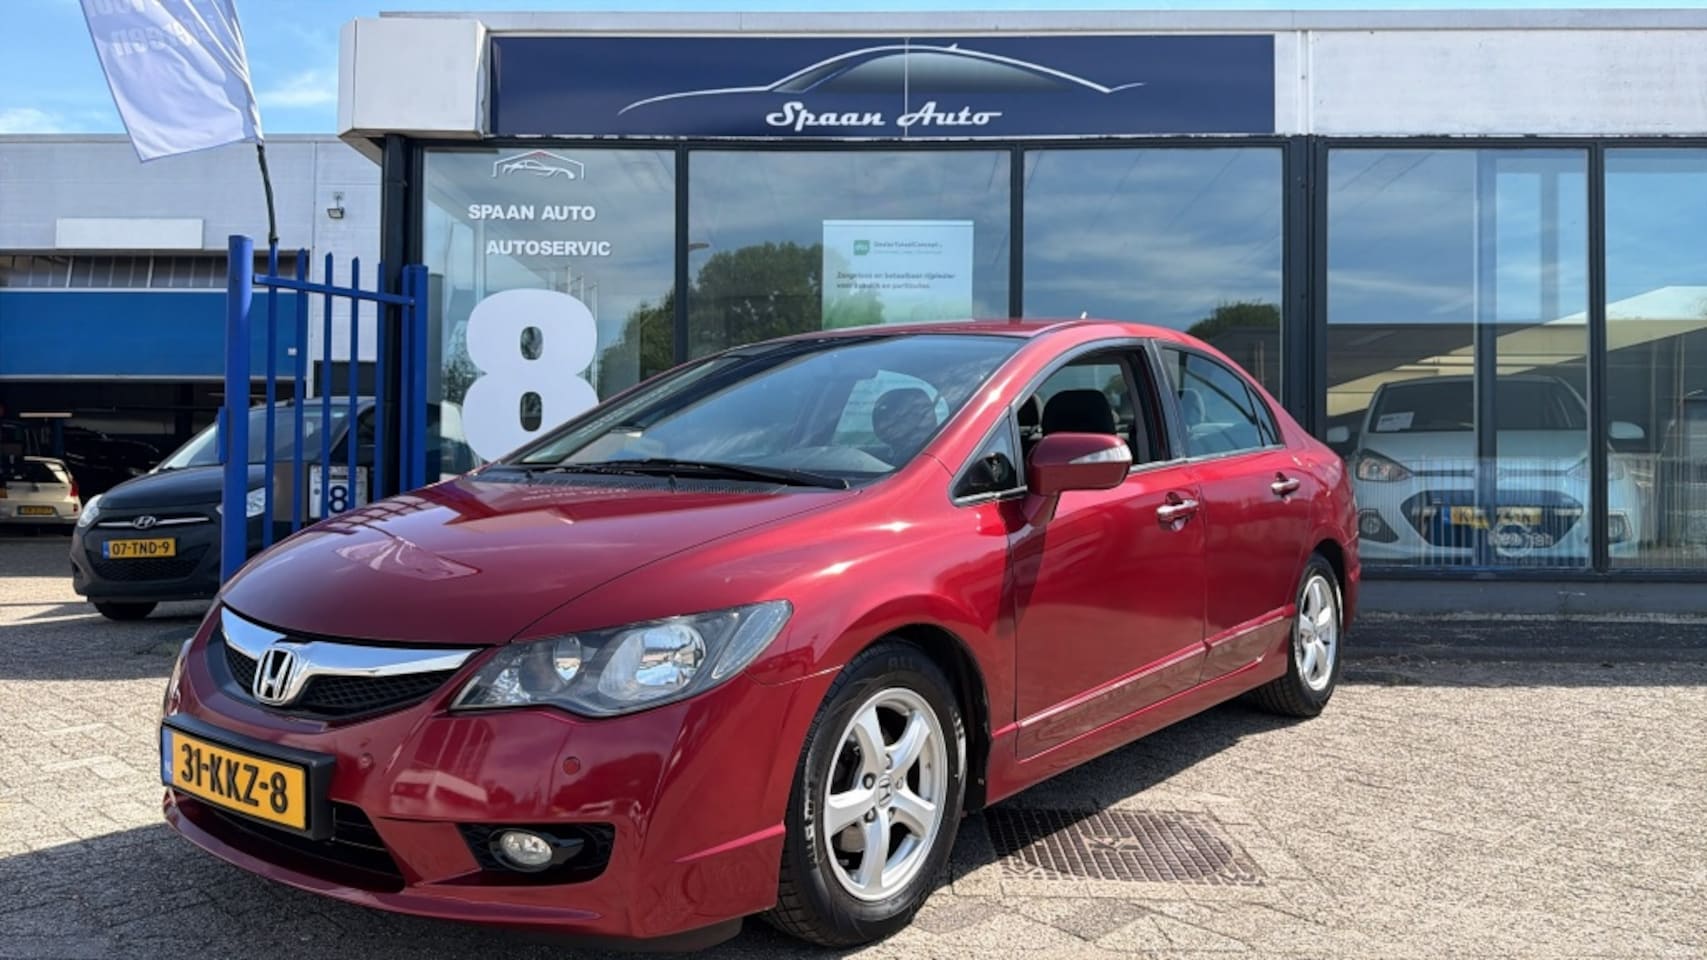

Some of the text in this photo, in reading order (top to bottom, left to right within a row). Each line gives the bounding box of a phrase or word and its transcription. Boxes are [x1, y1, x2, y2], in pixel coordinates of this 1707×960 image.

[766, 101, 1002, 131] Spaan Auto
[468, 204, 596, 221] SPAAN AUTO
[486, 239, 611, 256] AUTOSERVIC
[462, 288, 600, 465] 8
[328, 485, 349, 514] 8
[112, 541, 170, 556] 07-TND-9
[181, 743, 289, 814] 31-KKZ-8
